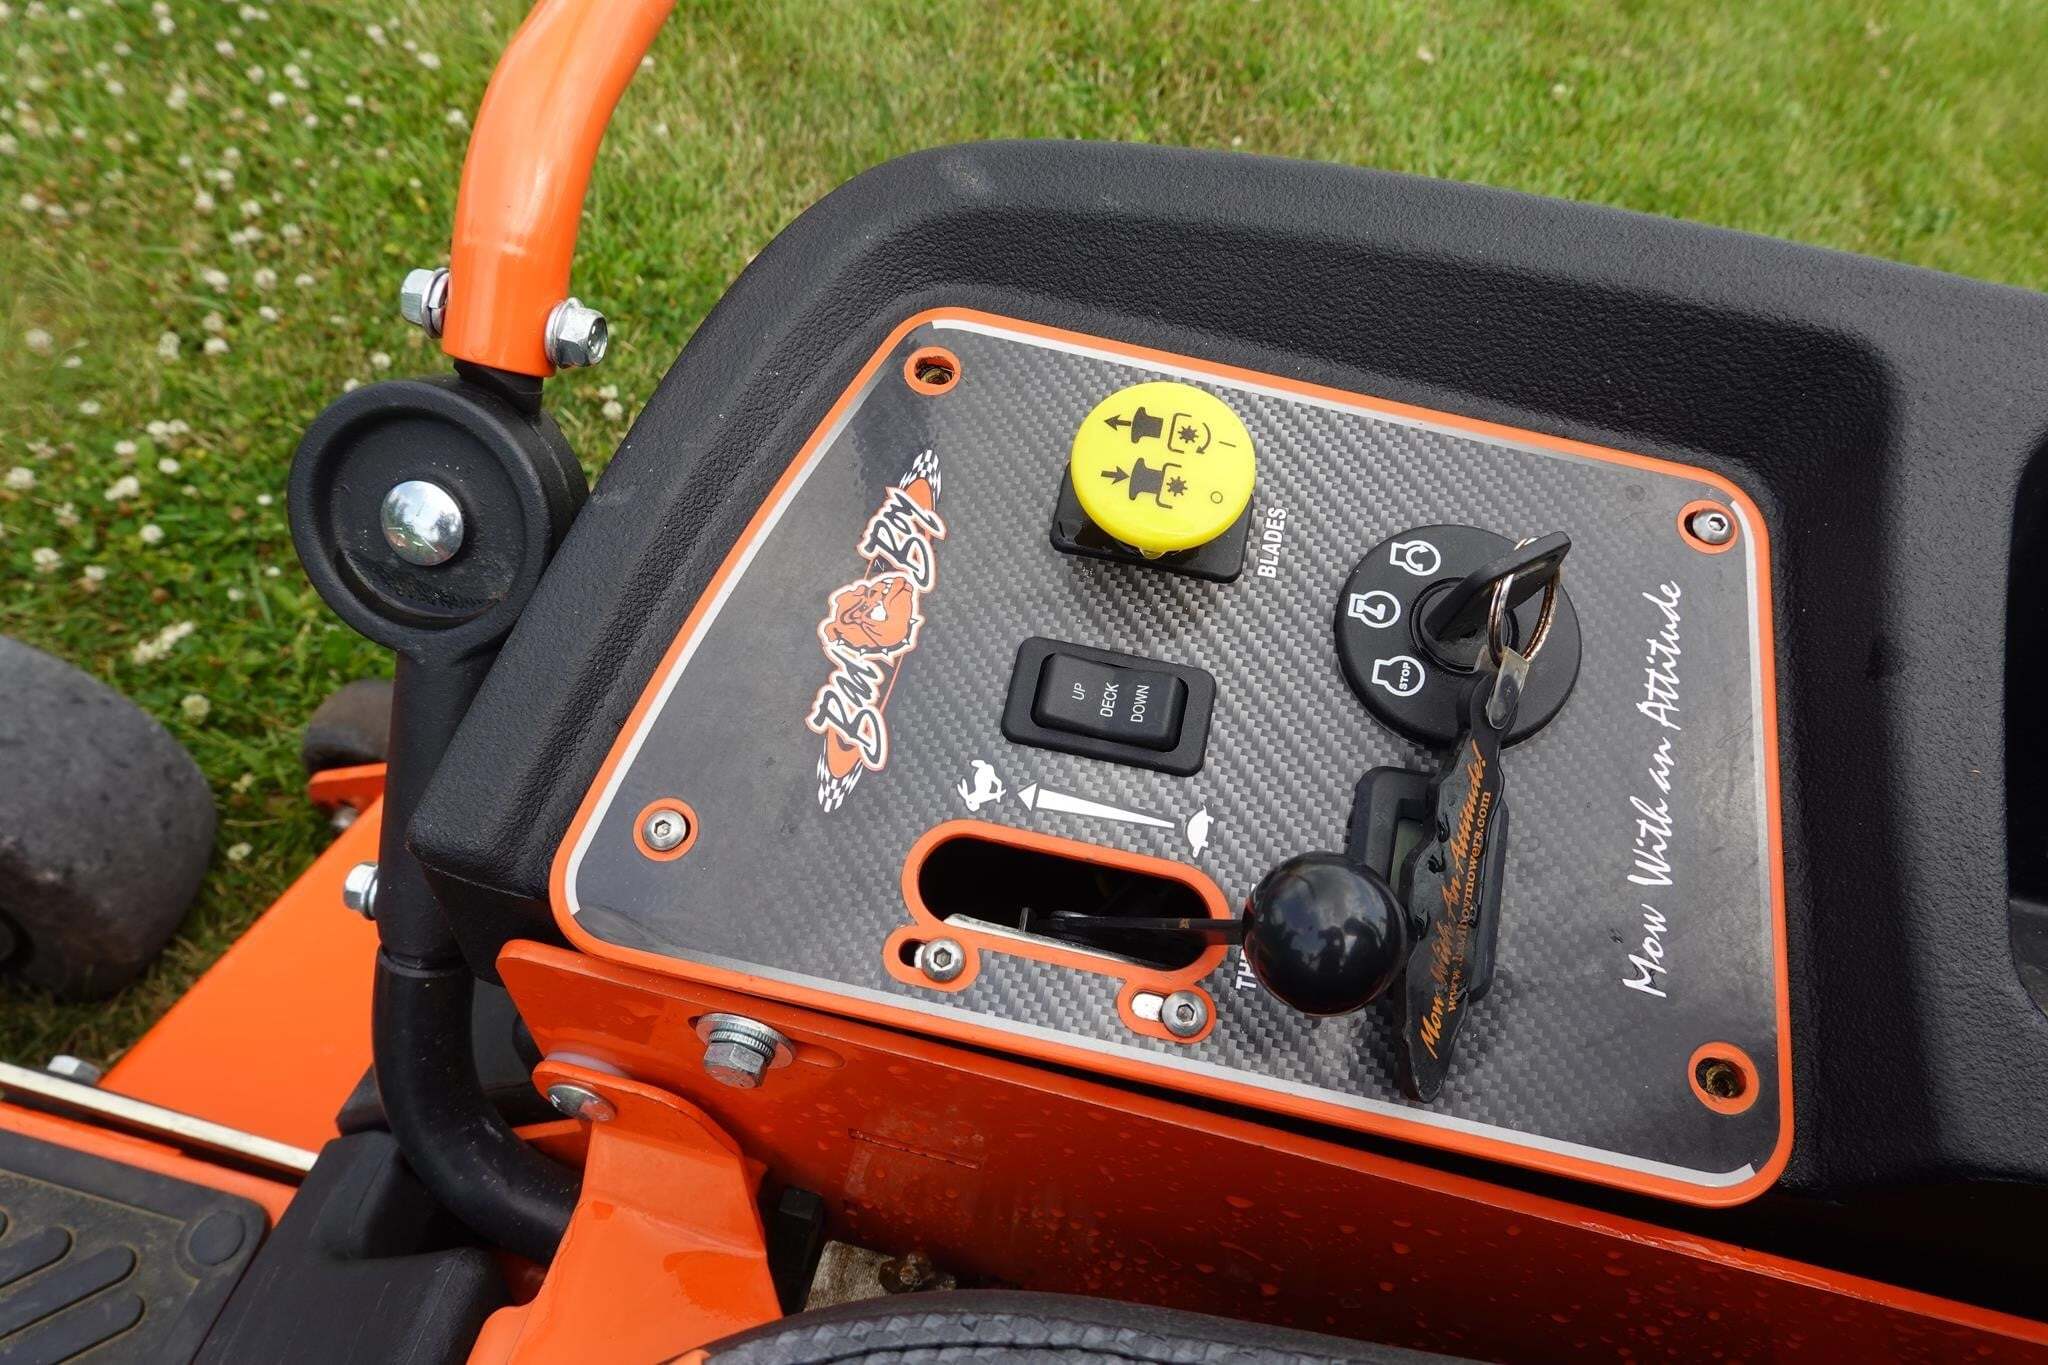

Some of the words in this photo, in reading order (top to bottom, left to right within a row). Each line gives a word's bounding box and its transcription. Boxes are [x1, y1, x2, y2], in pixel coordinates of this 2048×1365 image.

[1258, 506, 1288, 578] BLADES
[808, 648, 885, 768] Bad
[858, 488, 944, 590] Boy
[1636, 580, 1682, 731] Attitude
[1072, 682, 1086, 701] UP
[1100, 682, 1120, 718] DECK
[1130, 685, 1150, 723] DOWN
[1399, 662, 1411, 691] STOP
[1649, 736, 1675, 794] an
[1449, 738, 1487, 875] Attitude!
[1627, 796, 1673, 886] With
[1441, 874, 1462, 922] An
[1430, 919, 1453, 986] With
[1622, 903, 1668, 999] Mow
[1420, 990, 1444, 1060] Mow
